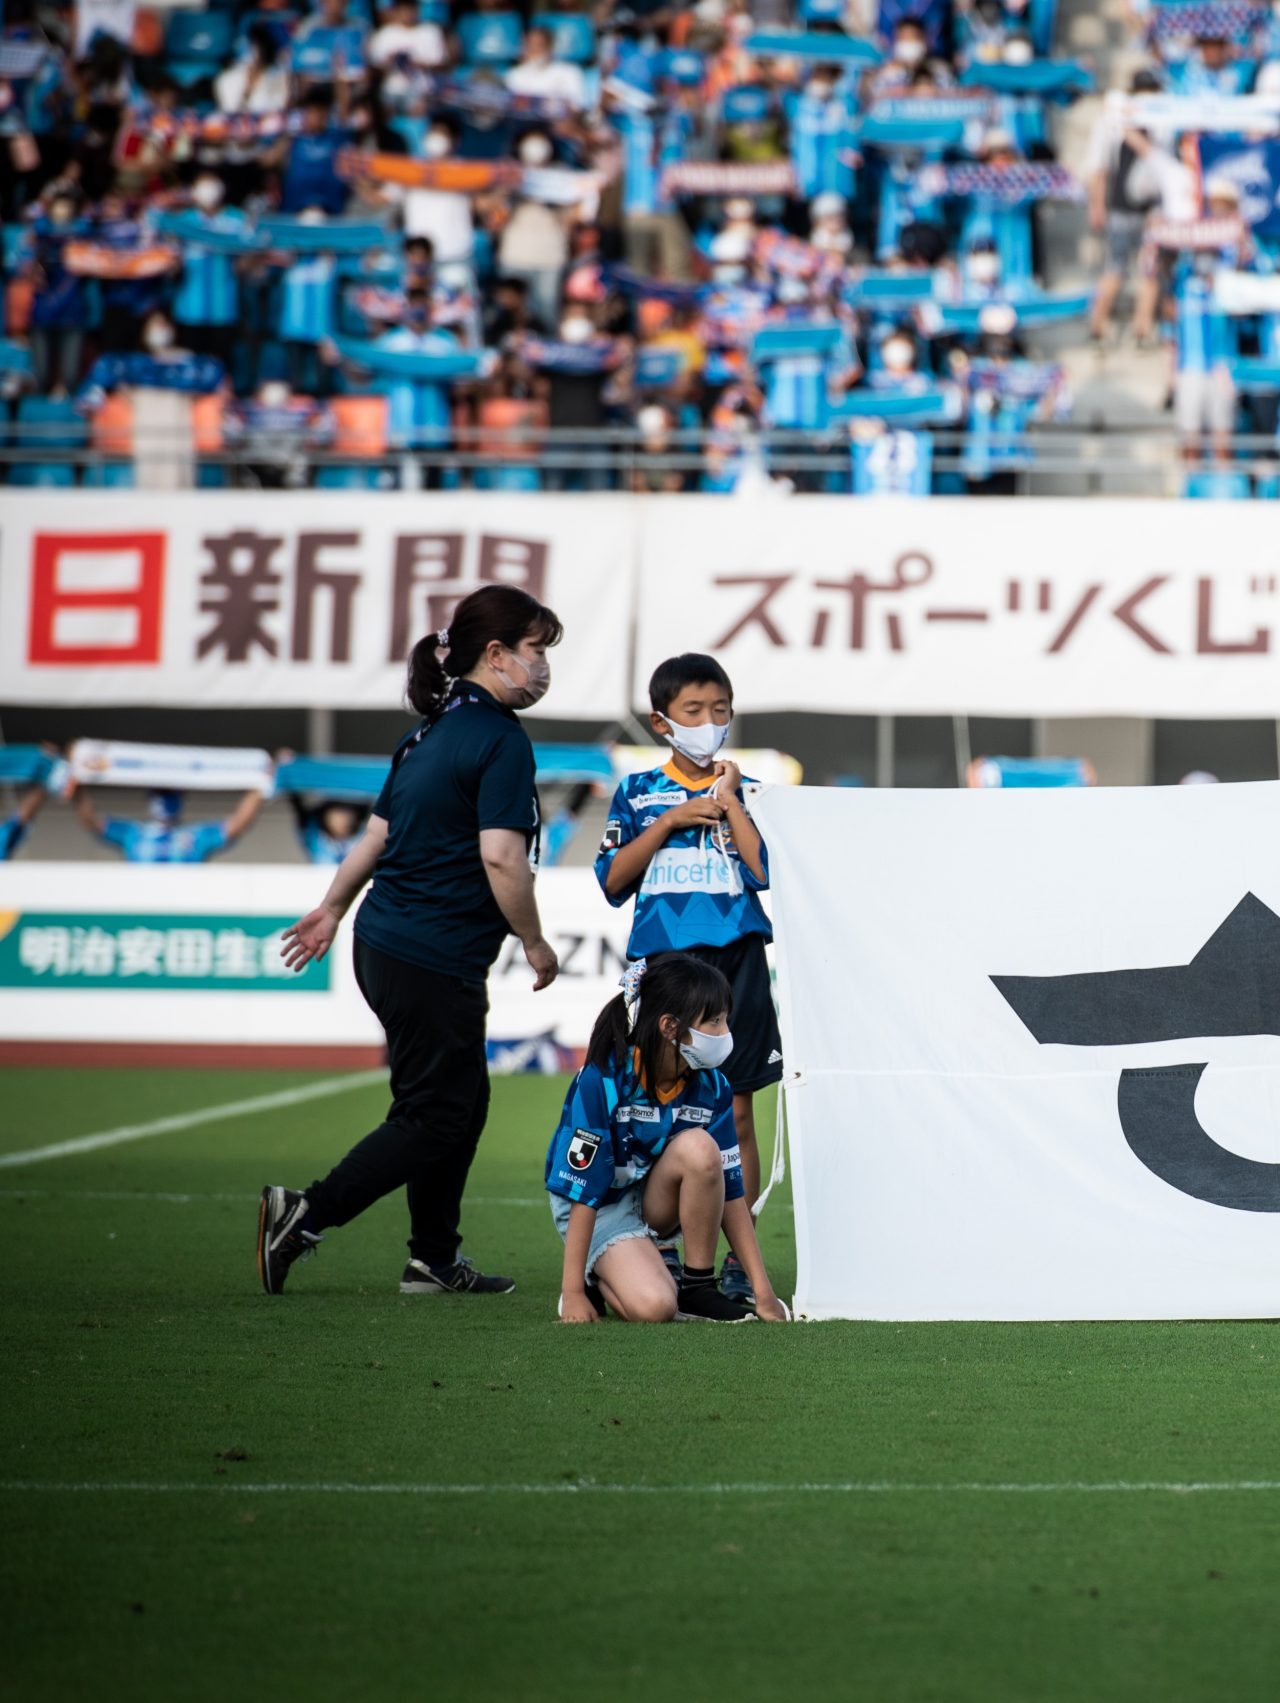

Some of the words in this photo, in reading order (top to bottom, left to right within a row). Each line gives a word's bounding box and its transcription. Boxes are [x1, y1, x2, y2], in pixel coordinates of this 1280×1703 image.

[711, 550, 1278, 656] スポーツくじ
[558, 1170, 587, 1187] NAGASAKI
